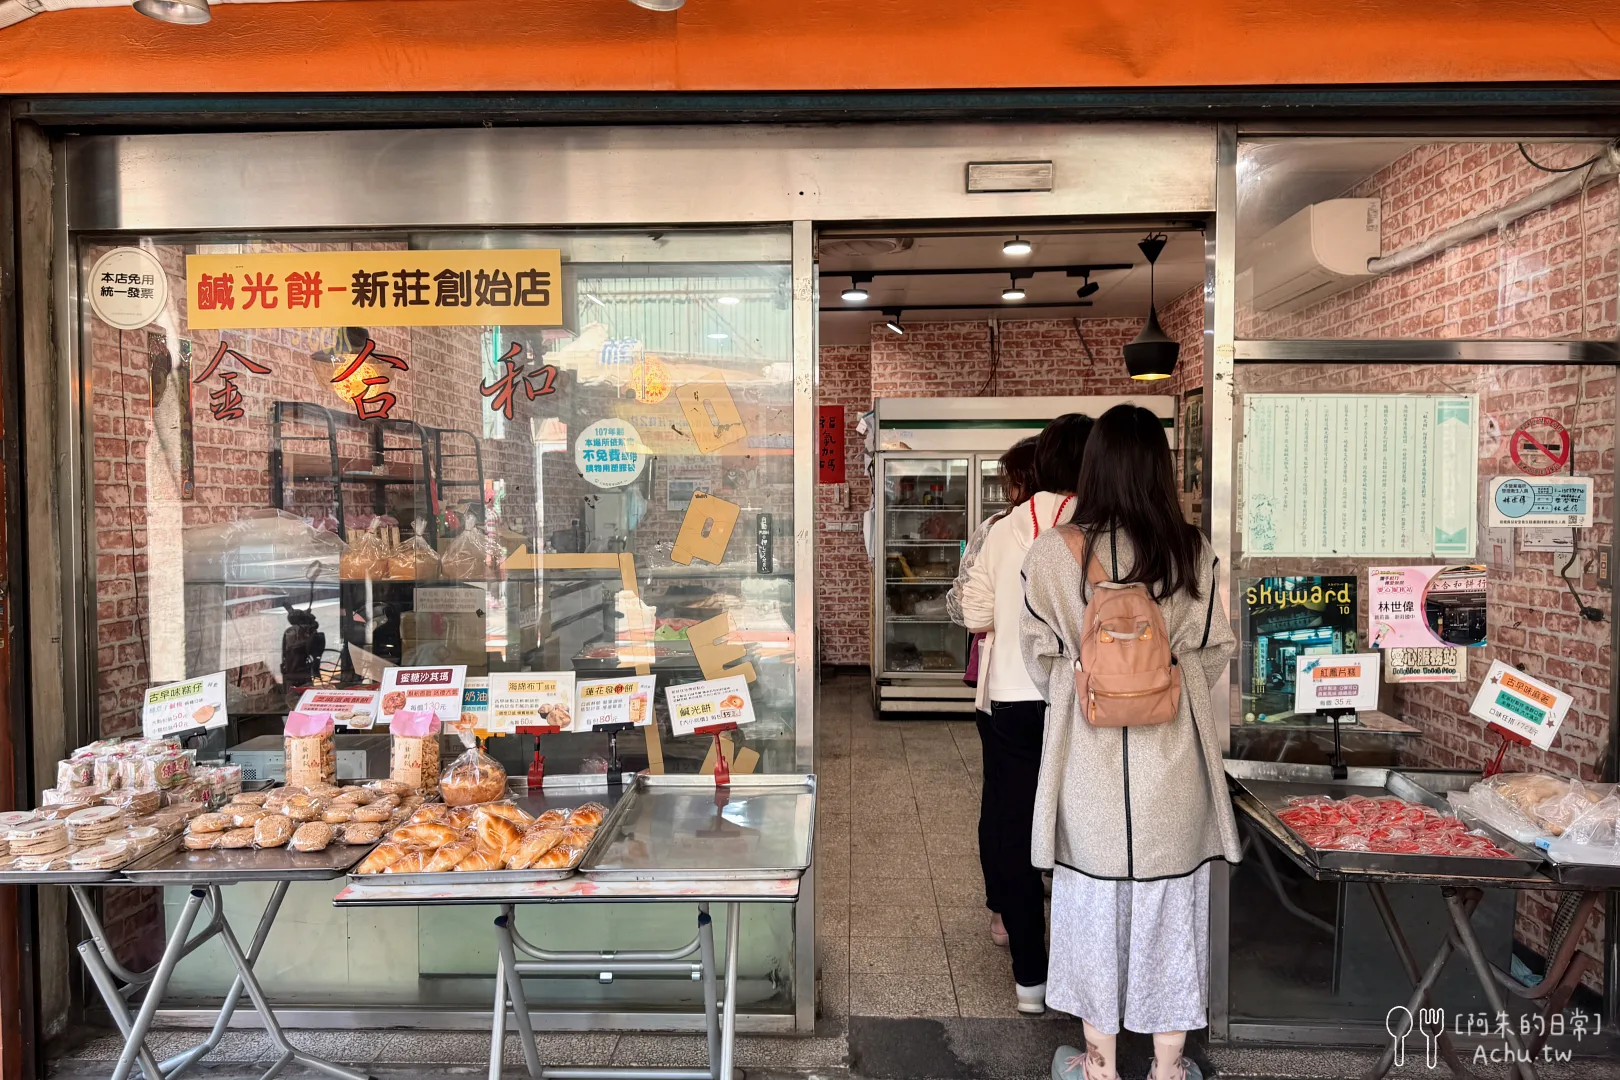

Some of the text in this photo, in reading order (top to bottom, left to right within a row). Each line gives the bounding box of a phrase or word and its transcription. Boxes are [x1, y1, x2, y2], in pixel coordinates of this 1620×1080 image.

[101, 272, 154, 285] 本店免用
[100, 286, 154, 299] 統一發票
[197, 268, 550, 310] 鹹光餅-新莊創始店
[1340, 606, 1350, 615] 10
[1378, 601, 1414, 612] 林世偉
[400, 672, 450, 683] 蜜糖沙其瑪
[464, 690, 488, 702] 奶油
